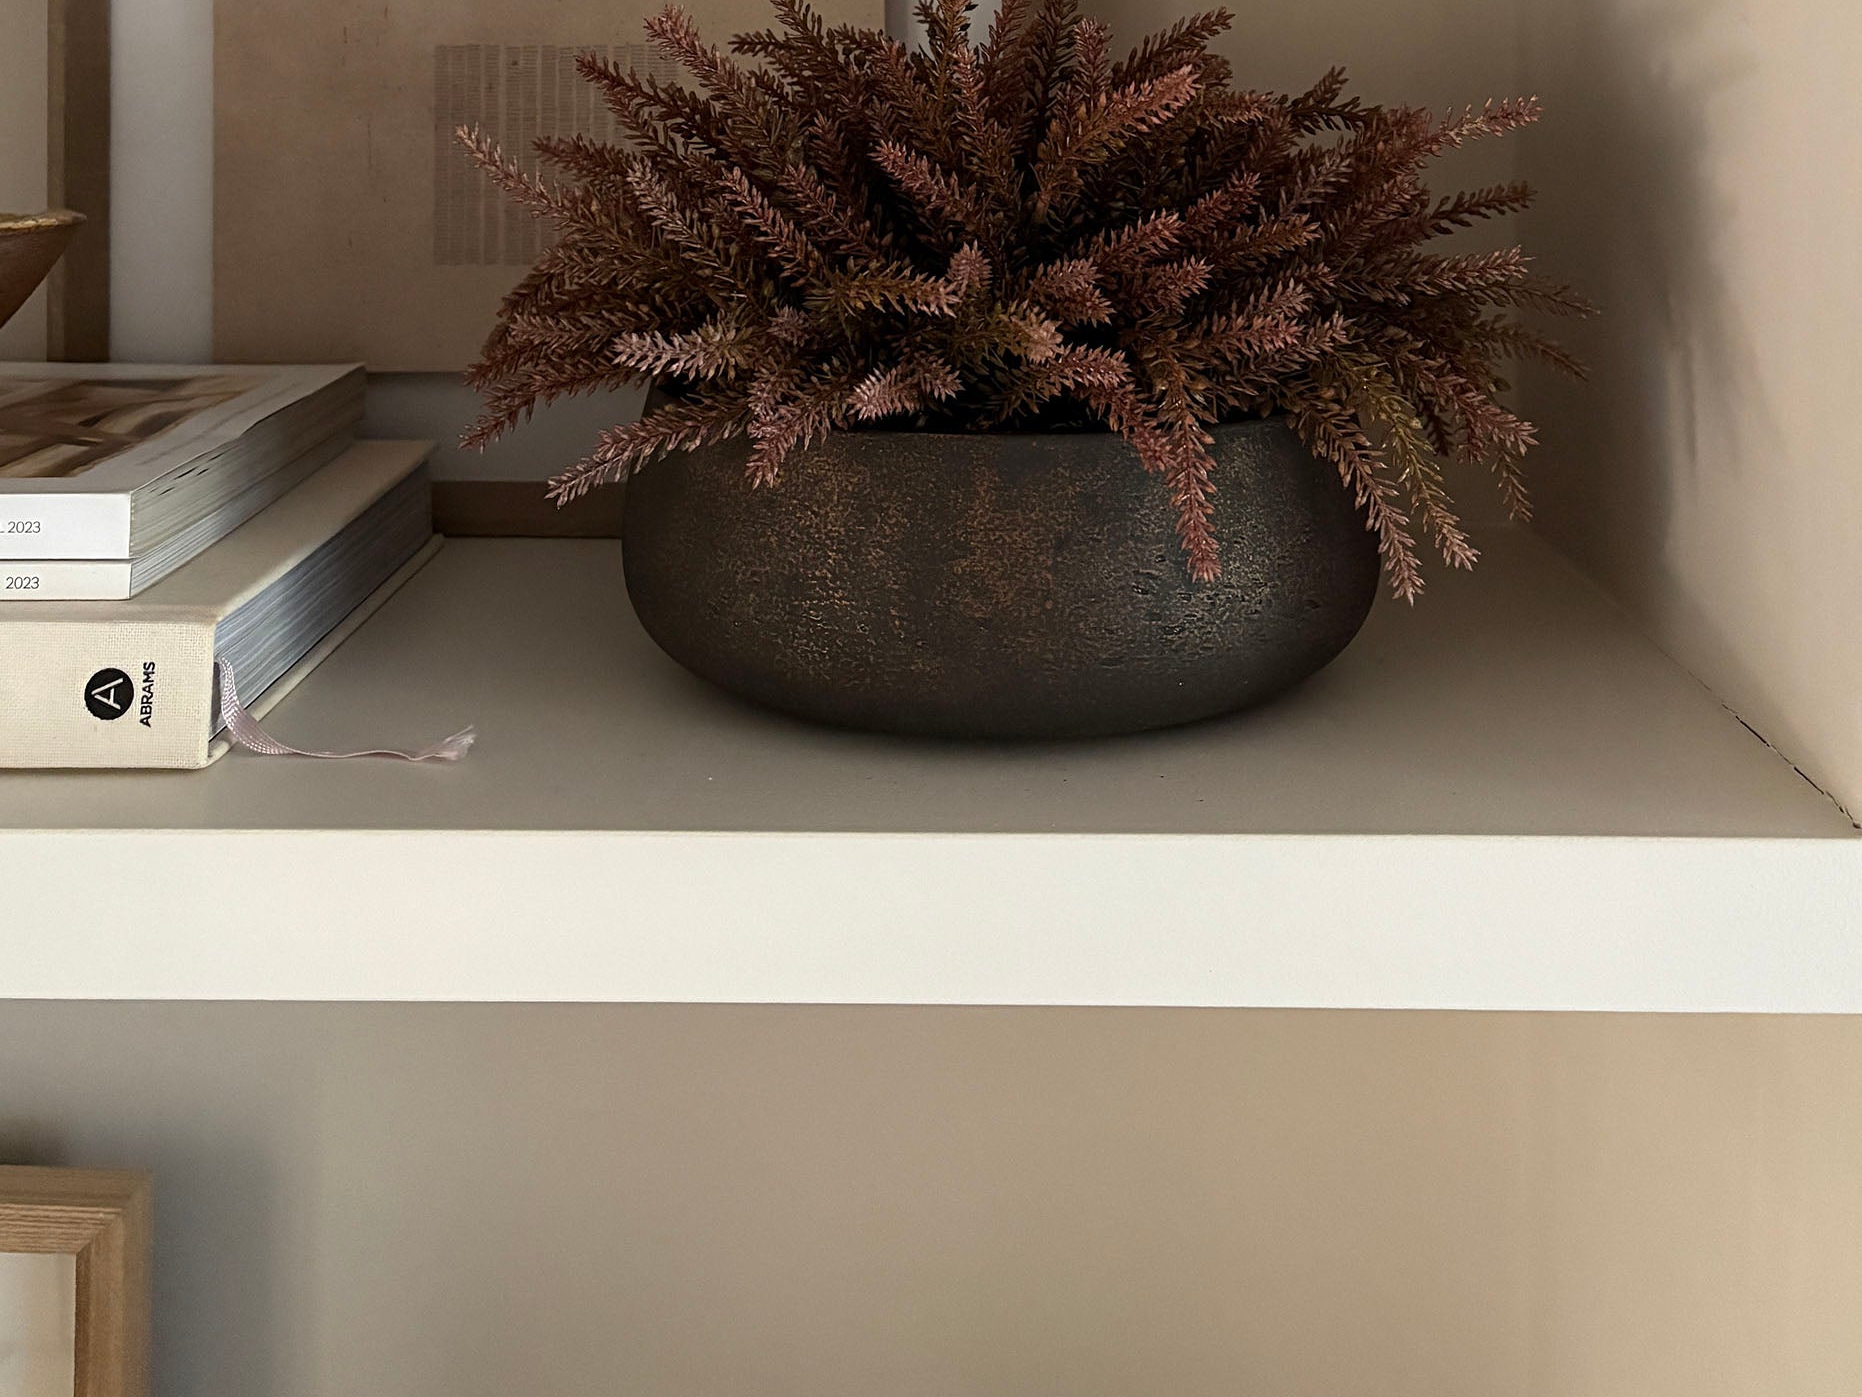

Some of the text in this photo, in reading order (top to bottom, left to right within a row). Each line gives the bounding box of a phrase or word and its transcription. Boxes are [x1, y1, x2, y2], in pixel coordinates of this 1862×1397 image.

[7, 521, 41, 534] 2023
[6, 576, 40, 590] 2023
[139, 661, 156, 728] ABRAMS
